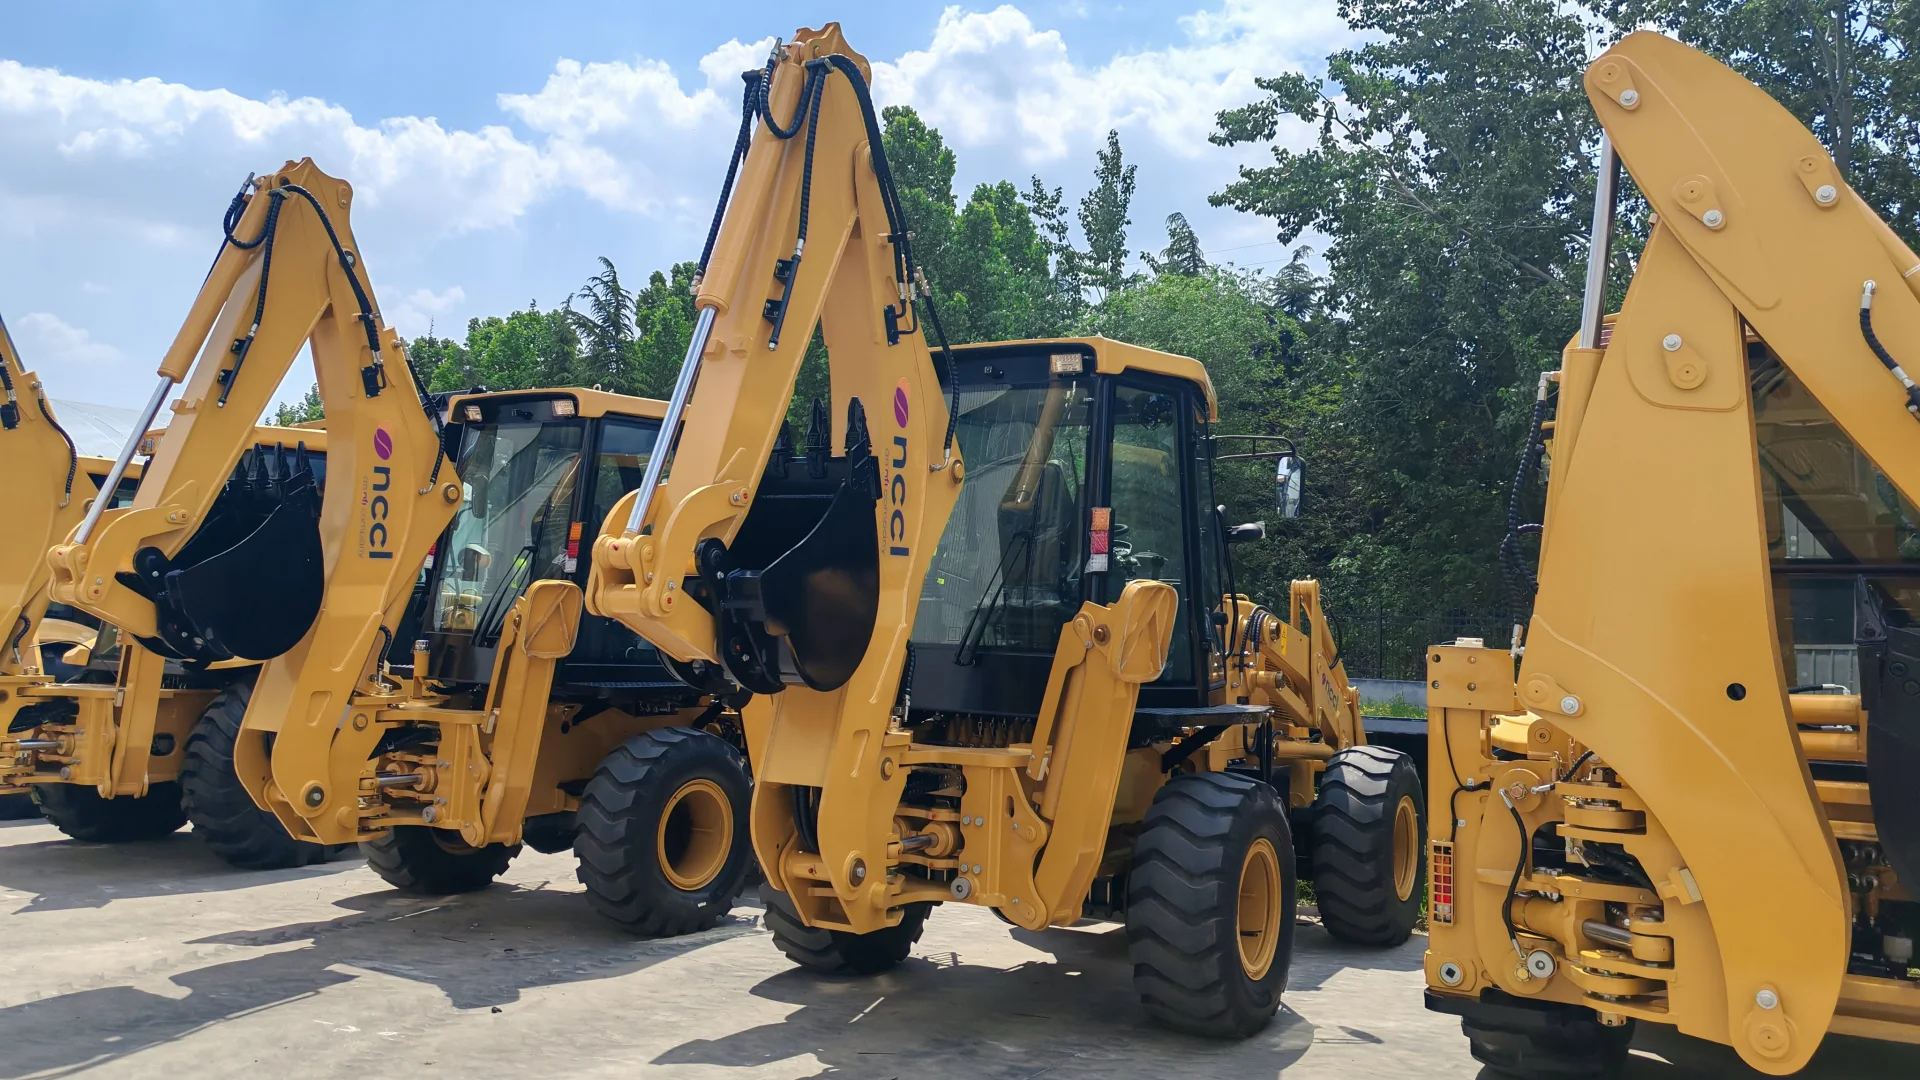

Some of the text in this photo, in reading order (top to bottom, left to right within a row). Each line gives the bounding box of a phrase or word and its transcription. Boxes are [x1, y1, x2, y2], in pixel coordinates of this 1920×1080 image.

[358, 508, 367, 558] company
[368, 466, 393, 559] nccl
[881, 489, 889, 556] company
[890, 436, 909, 556] nccl
